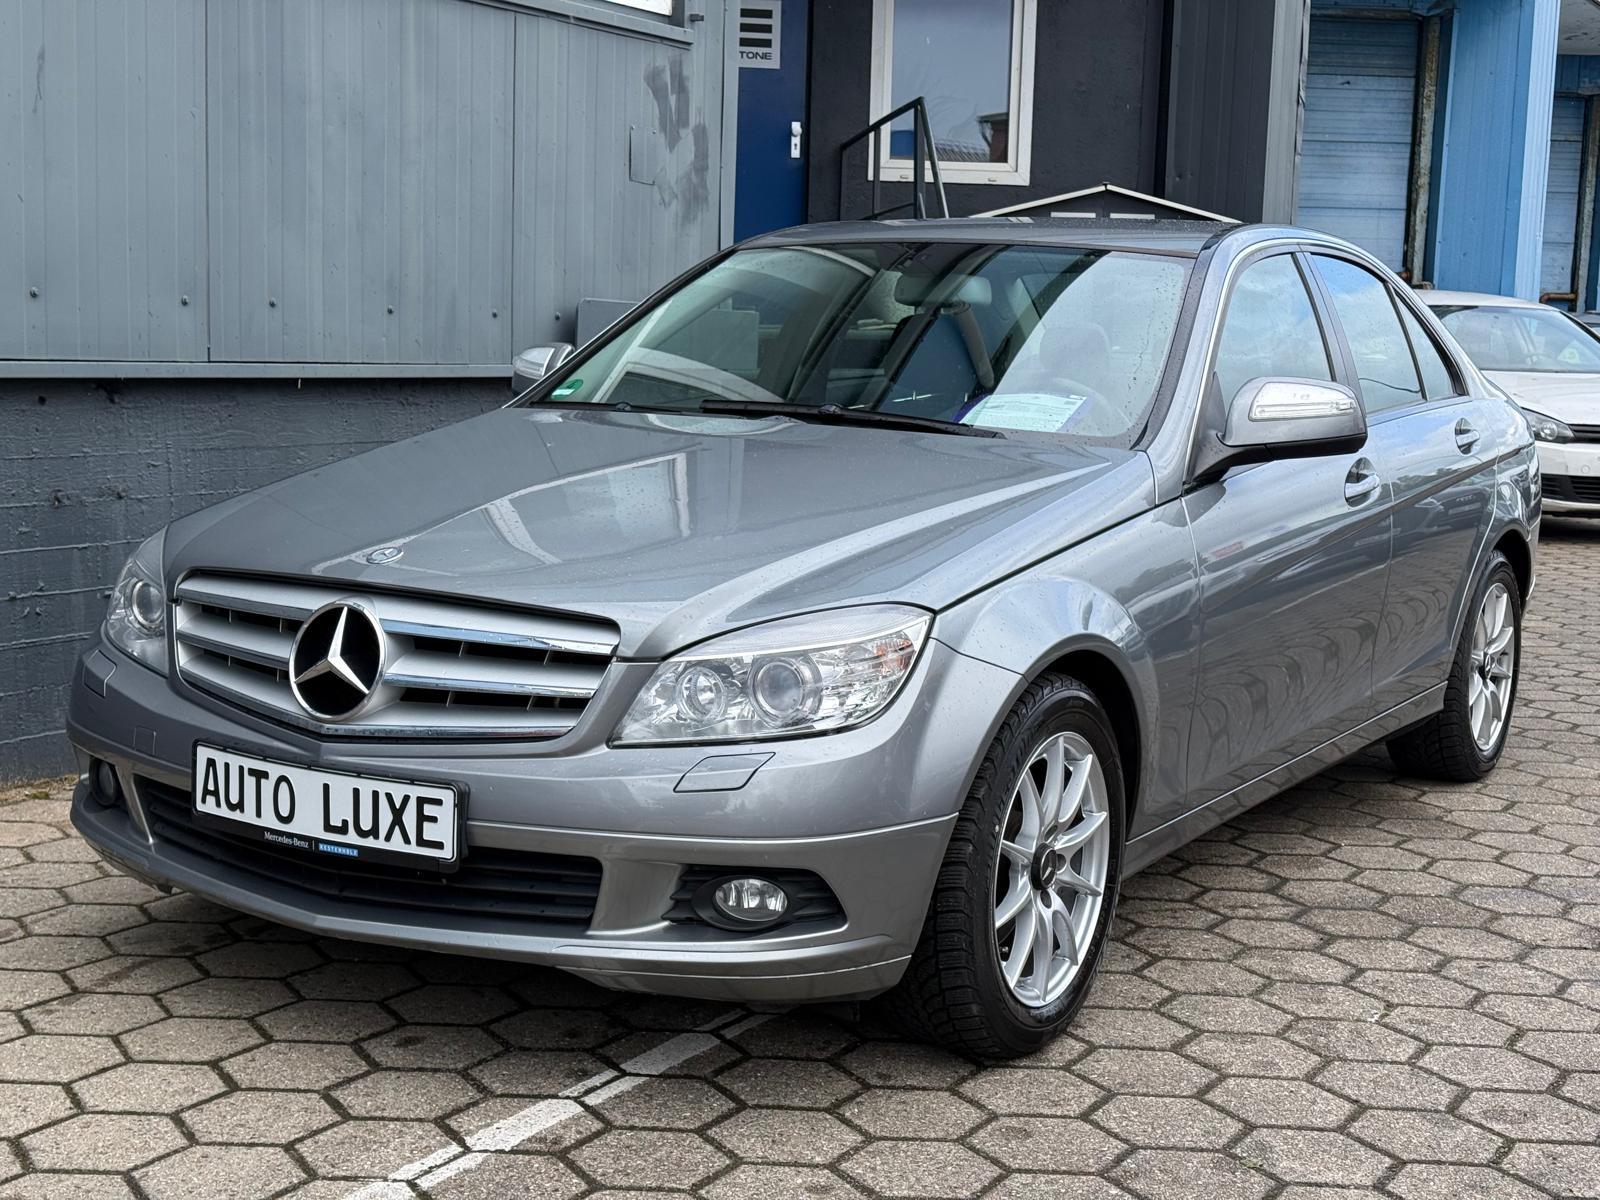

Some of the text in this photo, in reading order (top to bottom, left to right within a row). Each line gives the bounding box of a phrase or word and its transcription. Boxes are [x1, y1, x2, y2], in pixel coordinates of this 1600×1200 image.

[201, 757, 445, 850] AUTO LUXE
[264, 831, 309, 849] Mercedes-Benz
